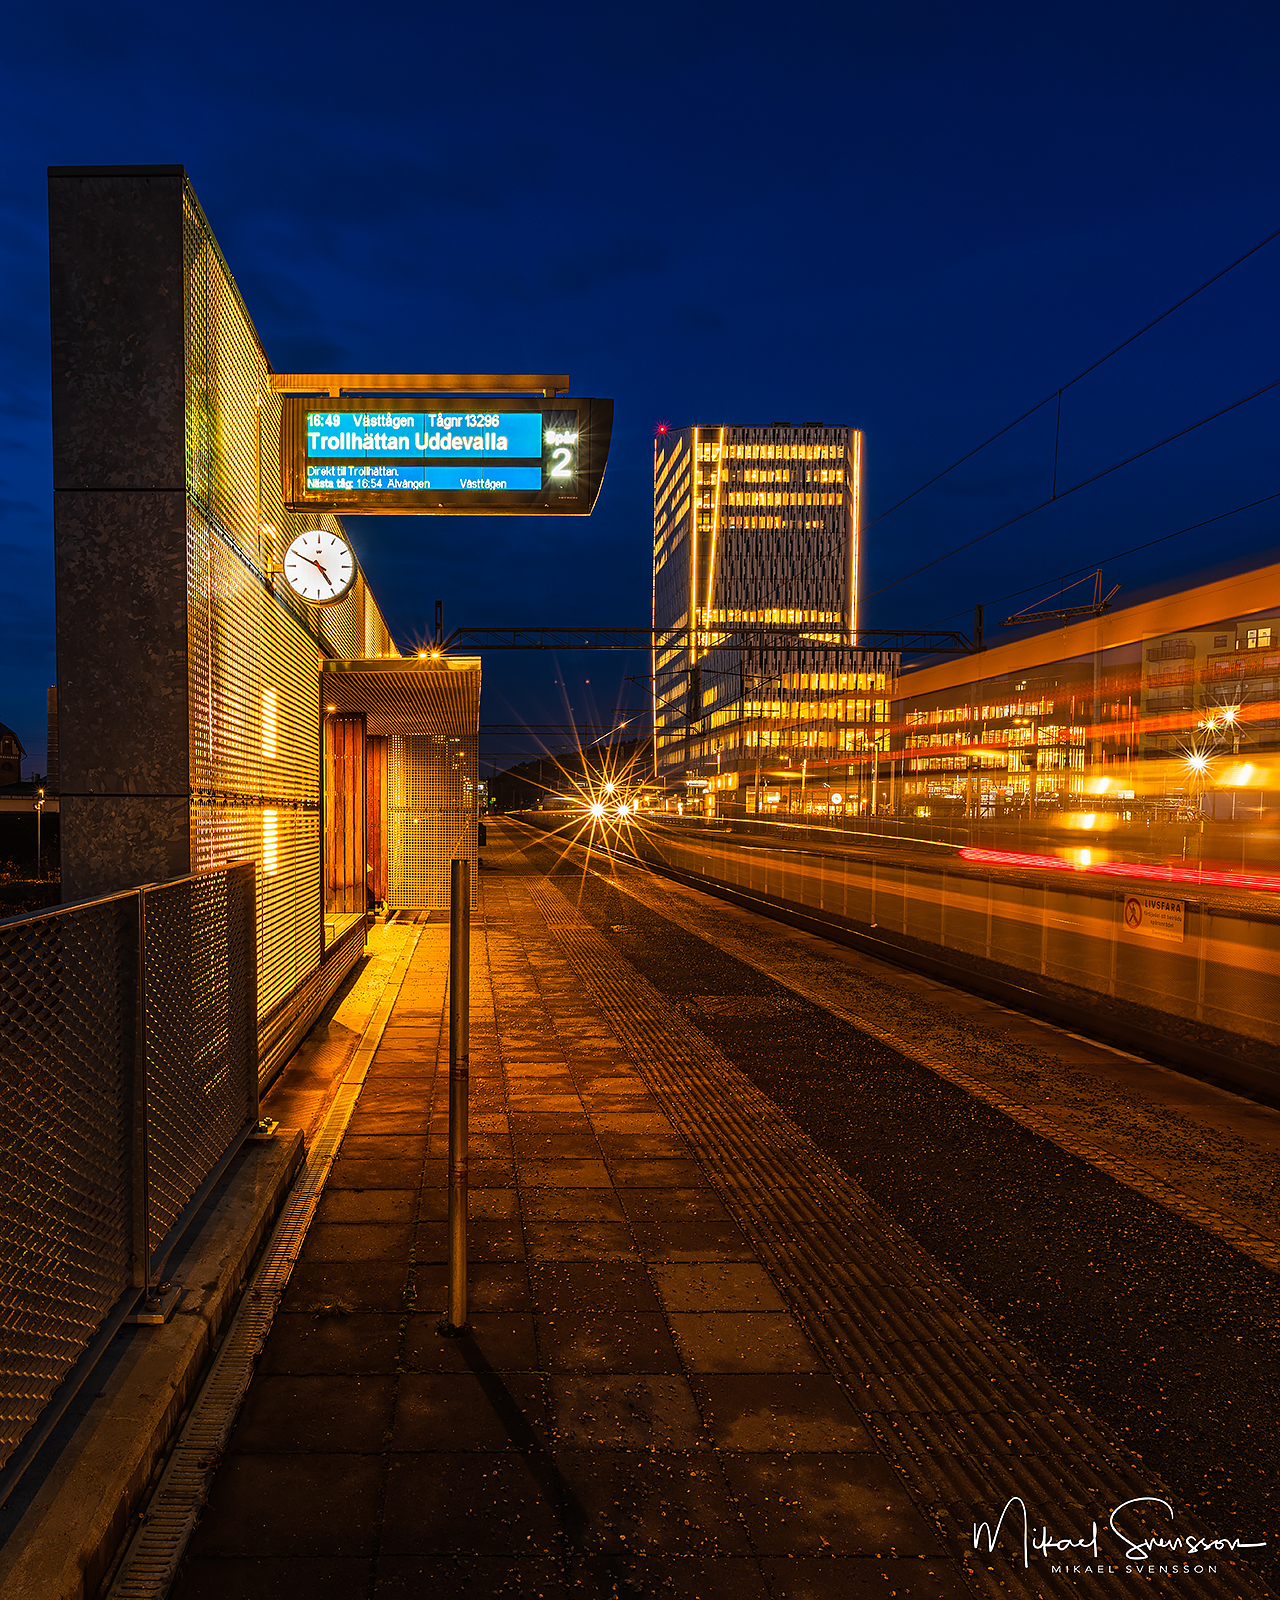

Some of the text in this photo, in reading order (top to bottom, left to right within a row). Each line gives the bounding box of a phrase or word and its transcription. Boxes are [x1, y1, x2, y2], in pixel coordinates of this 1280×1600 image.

[307, 412, 500, 430] 16:49 Västtågen Tågnr 13296
[307, 432, 509, 450] Trollhättan Uddevalla
[546, 431, 578, 447] Spår
[551, 448, 572, 477] 2
[307, 466, 336, 477] Direkt
[337, 466, 347, 477] till
[307, 479, 334, 489] Nästa
[357, 479, 383, 489] 16:54
[460, 479, 508, 490] Västtågen
[1144, 899, 1182, 913] LIVSFARA
